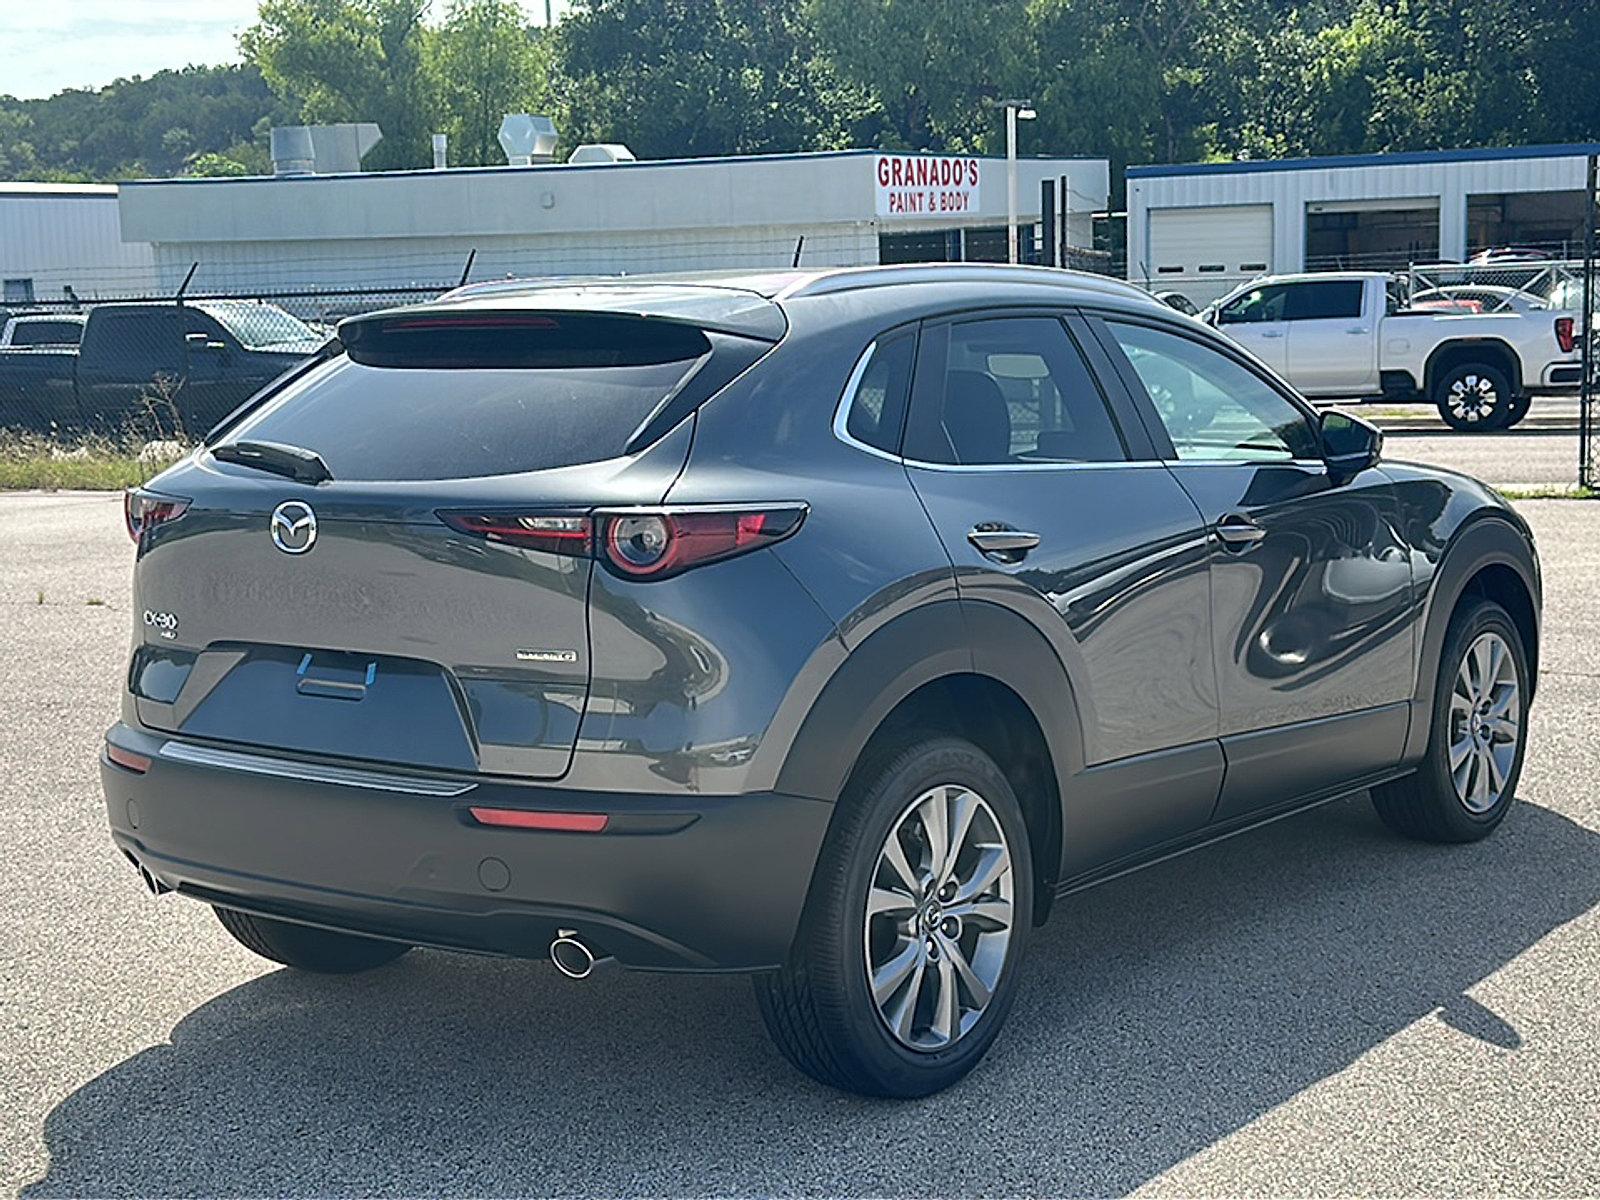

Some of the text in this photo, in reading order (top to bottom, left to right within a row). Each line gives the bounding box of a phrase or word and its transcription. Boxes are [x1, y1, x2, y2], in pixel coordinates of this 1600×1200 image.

[878, 157, 979, 188] GRANADO'S
[889, 191, 970, 213] PAINT & BODY
[143, 609, 178, 630] CX-30
